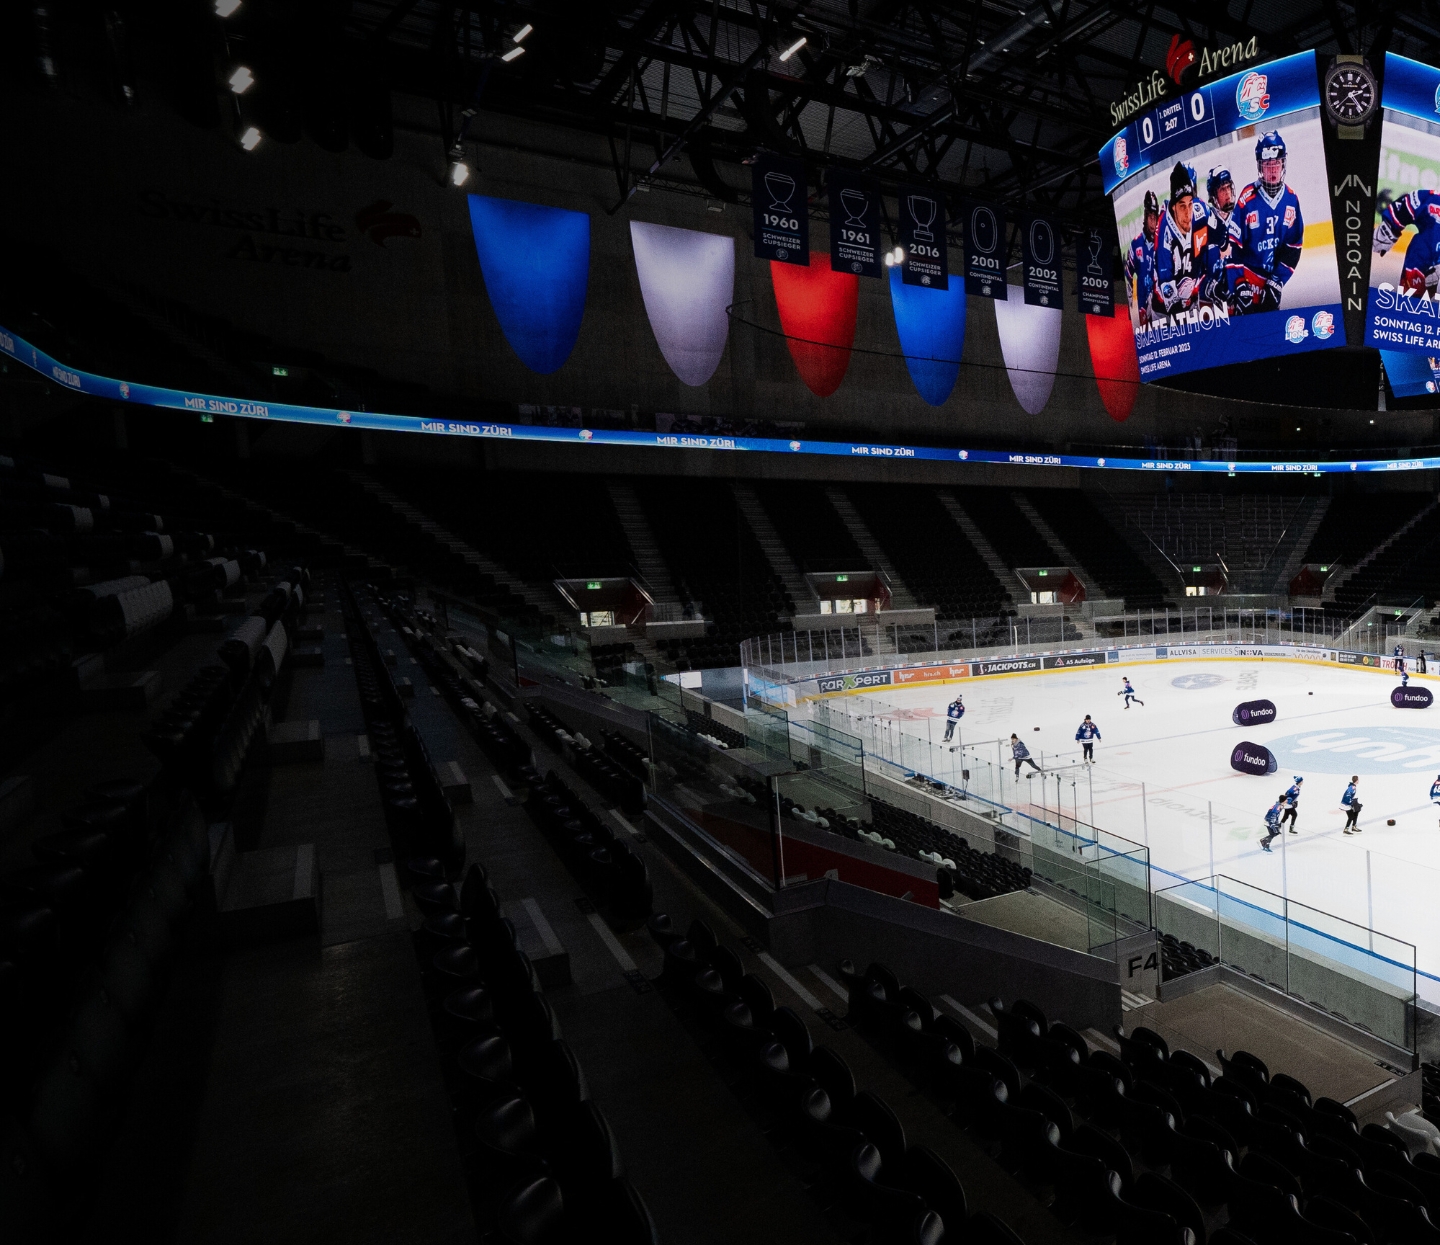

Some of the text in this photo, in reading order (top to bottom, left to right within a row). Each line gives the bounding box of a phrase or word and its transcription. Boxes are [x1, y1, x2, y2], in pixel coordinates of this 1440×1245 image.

[1199, 36, 1258, 77] Arena
[1111, 70, 1167, 127] SwissLife
[1191, 92, 1205, 121] 0
[1142, 117, 1154, 144] 0
[138, 190, 347, 243] SwissLife
[763, 213, 799, 231] 1960
[841, 229, 871, 245] 1961
[225, 234, 352, 273] Arena
[909, 243, 940, 258] 2016
[971, 255, 1000, 270] 2001
[1028, 266, 1058, 281] 2002
[1082, 276, 1109, 289] 2009
[1135, 301, 1231, 350] SKATEATHON
[1374, 316, 1422, 334] SONNTAG
[1423, 325, 1435, 336] 12.
[1373, 329, 1403, 343] SWISS
[1405, 335, 1424, 347] LIFE
[1178, 342, 1191, 354] 2023
[185, 397, 269, 417] MIR SIND ZÜRI
[421, 422, 512, 437] MIR SIND ZÜRI
[656, 436, 735, 449] MIR SIND ZÜRI
[851, 447, 915, 457] MIR SIND ZÜRI
[1009, 455, 1061, 465] MIR SIND ZÜRI
[1141, 462, 1191, 471] MIR SIND ZÜRI
[1302, 463, 1318, 472] ZÜRI
[1387, 462, 1397, 470] MIR
[1169, 648, 1197, 657] ALLVISA
[1202, 647, 1233, 656] SERVICES
[987, 661, 1036, 673] JACKPOTS.CH
[1404, 694, 1429, 702] fundoo
[1250, 708, 1274, 718] fundoo
[1243, 753, 1266, 767] fundoo
[1128, 952, 1160, 978] F4
